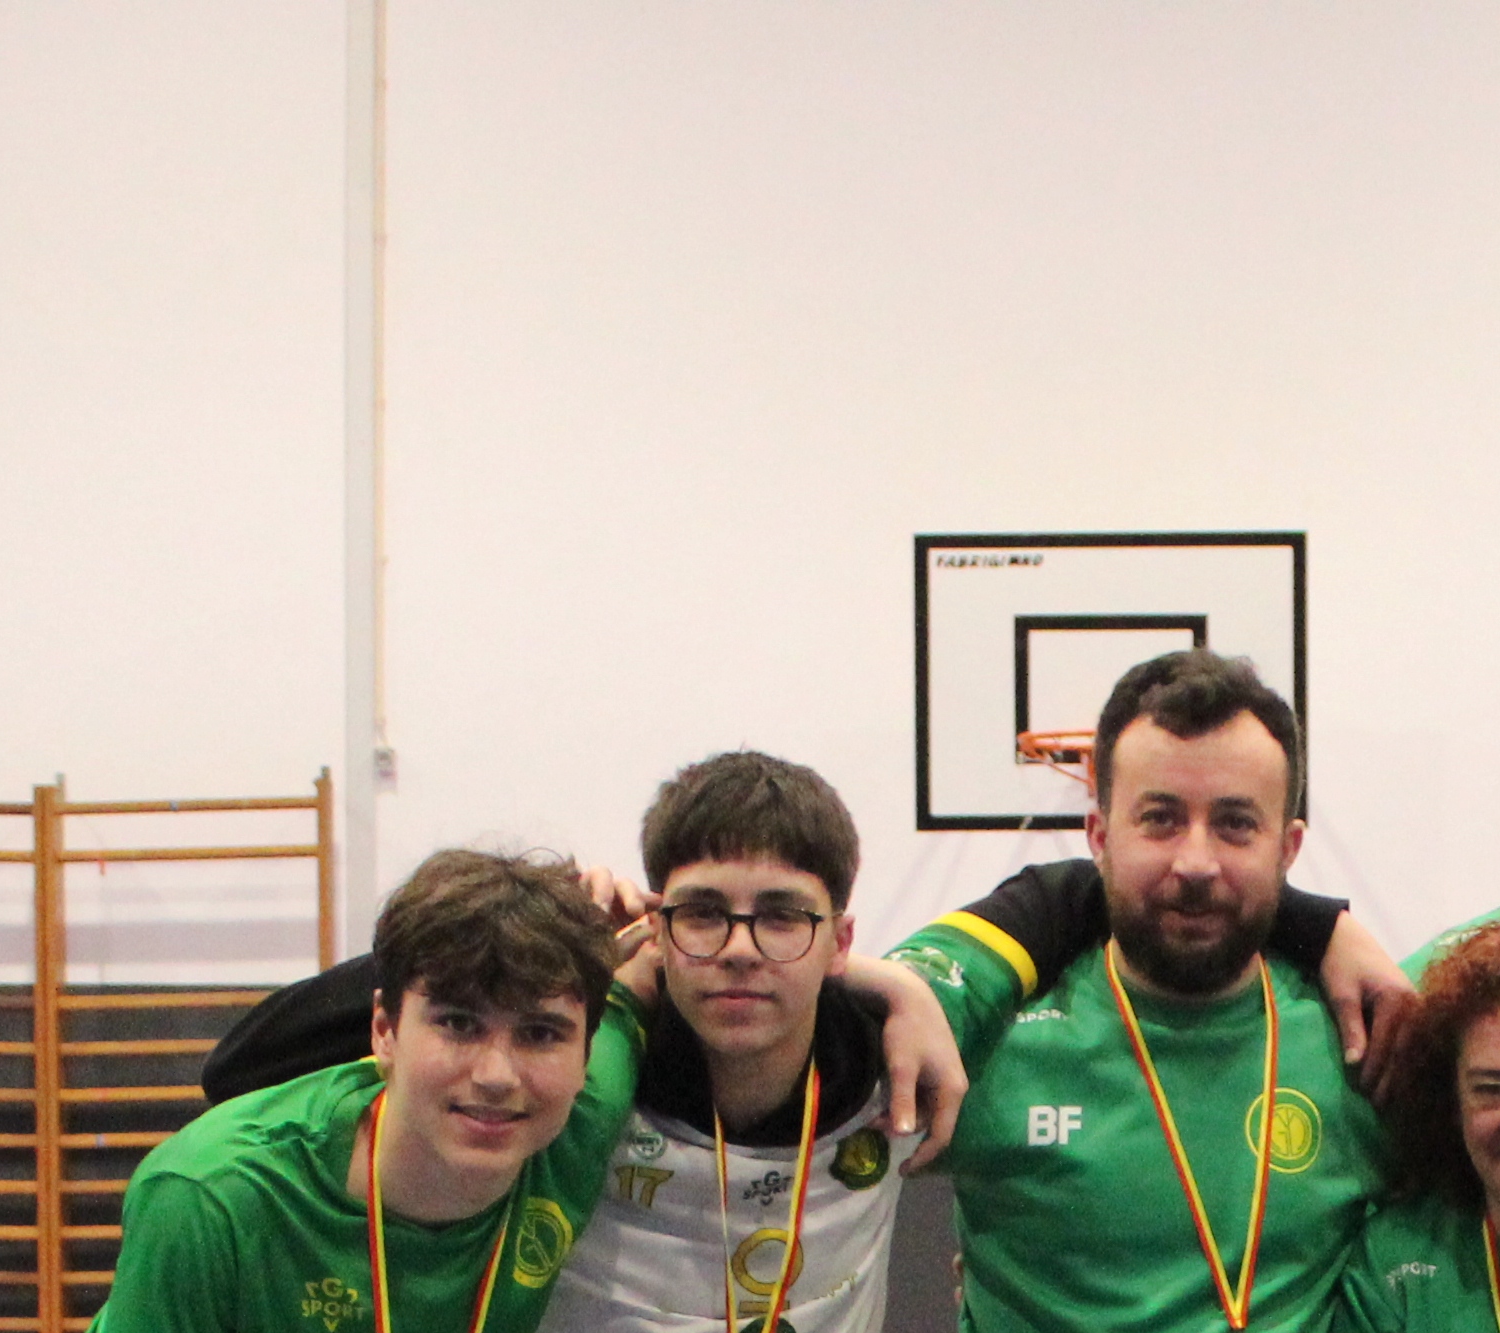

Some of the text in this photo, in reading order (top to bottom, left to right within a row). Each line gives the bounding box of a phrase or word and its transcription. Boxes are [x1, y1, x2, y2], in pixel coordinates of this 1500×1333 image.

[1027, 1106, 1083, 1146] BF
[614, 1165, 675, 1208] 17
[301, 1299, 365, 1321] SPORT
